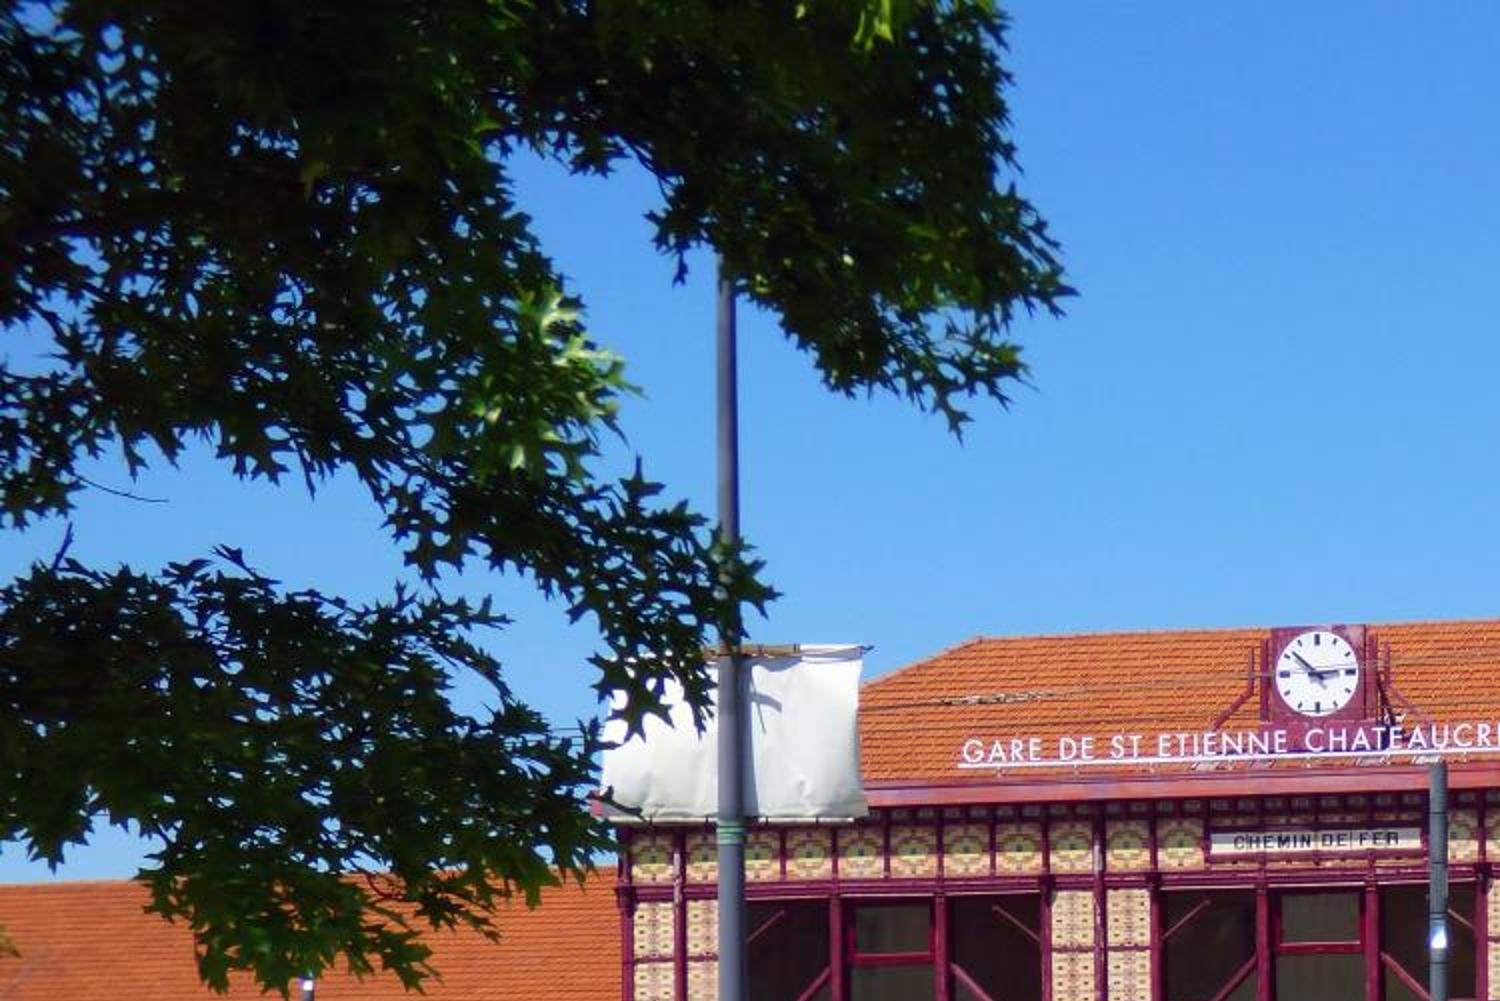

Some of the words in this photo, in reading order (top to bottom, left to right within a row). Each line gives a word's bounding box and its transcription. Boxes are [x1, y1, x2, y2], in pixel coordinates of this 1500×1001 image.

[962, 737, 1042, 764] GARE
[1059, 736, 1095, 761] DE
[1111, 734, 1143, 759] ST
[1158, 729, 1289, 757] ETIENNE
[1233, 833, 1312, 851] CHEMIN
[1321, 833, 1348, 847] DE
[1359, 831, 1399, 847] FER
